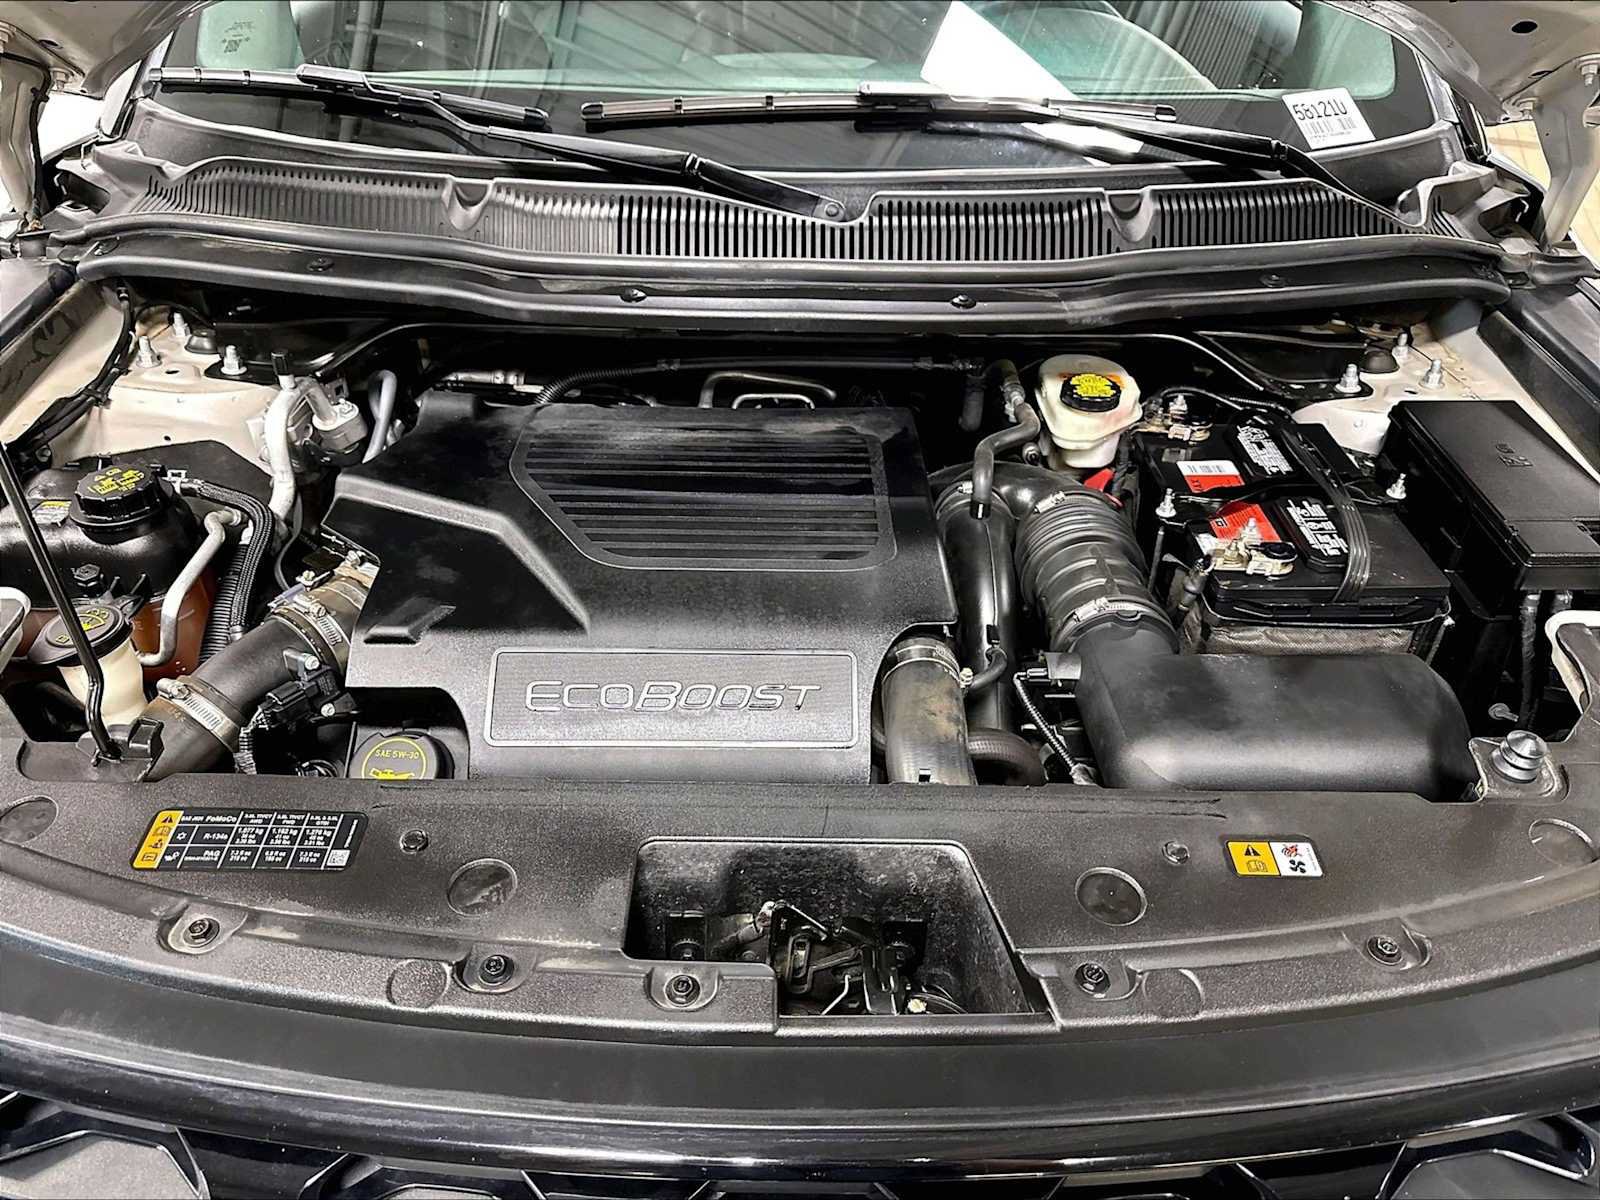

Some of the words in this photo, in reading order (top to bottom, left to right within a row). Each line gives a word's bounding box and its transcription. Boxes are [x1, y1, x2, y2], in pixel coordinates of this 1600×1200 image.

[525, 680, 820, 711] ECOBOOST
[375, 749, 392, 758] SAE
[392, 750, 420, 760] 5W-30
[205, 815, 238, 823] FoMoCo
[203, 832, 229, 840] R-134a
